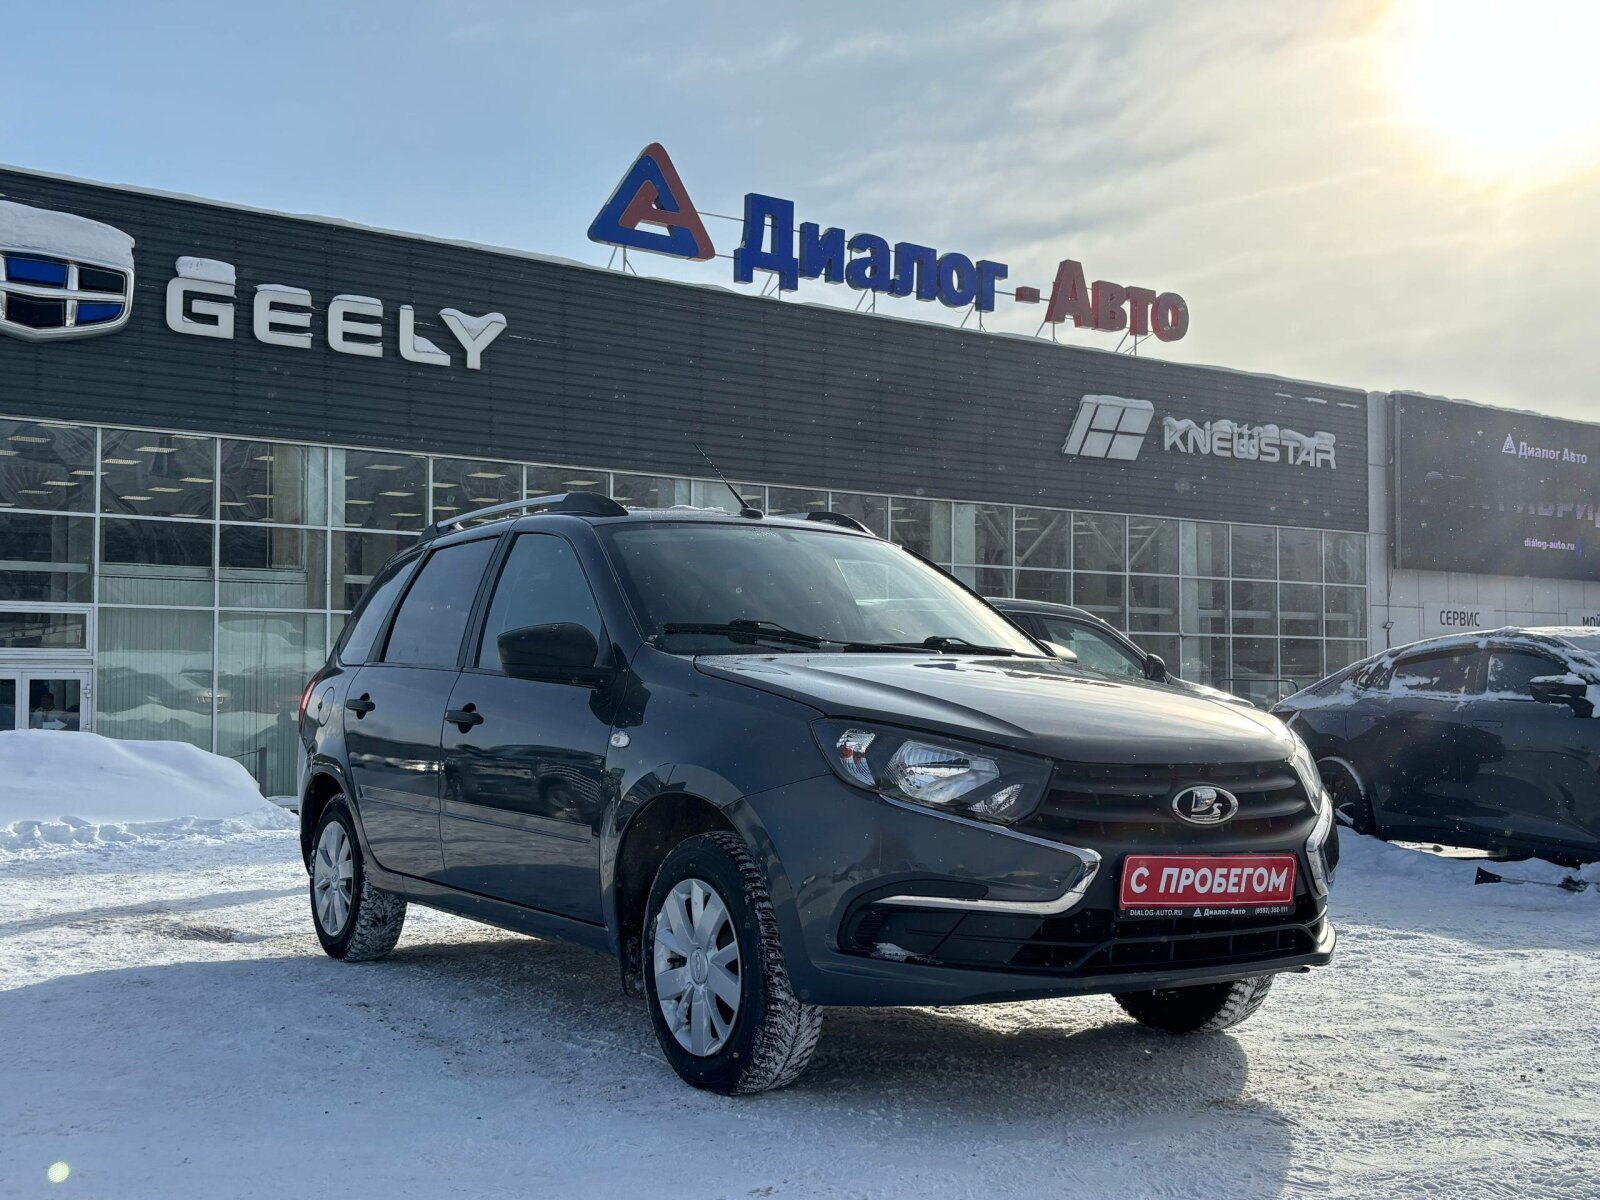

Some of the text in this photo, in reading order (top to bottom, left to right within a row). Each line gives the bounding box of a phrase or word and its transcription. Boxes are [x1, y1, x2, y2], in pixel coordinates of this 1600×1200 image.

[165, 264, 507, 370] GEELY
[1163, 418, 1337, 470] KNEWSTAR
[1518, 441, 1588, 465] Диалог Авто
[1524, 538, 1576, 551] dialog-auto.ru
[1439, 610, 1481, 627] СЕРВИС
[1130, 866, 1288, 893] С ПРОБЕГОМ
[1129, 908, 1183, 917] DIALOG-AUTO.RU
[1203, 908, 1246, 918] Диалог-Авто
